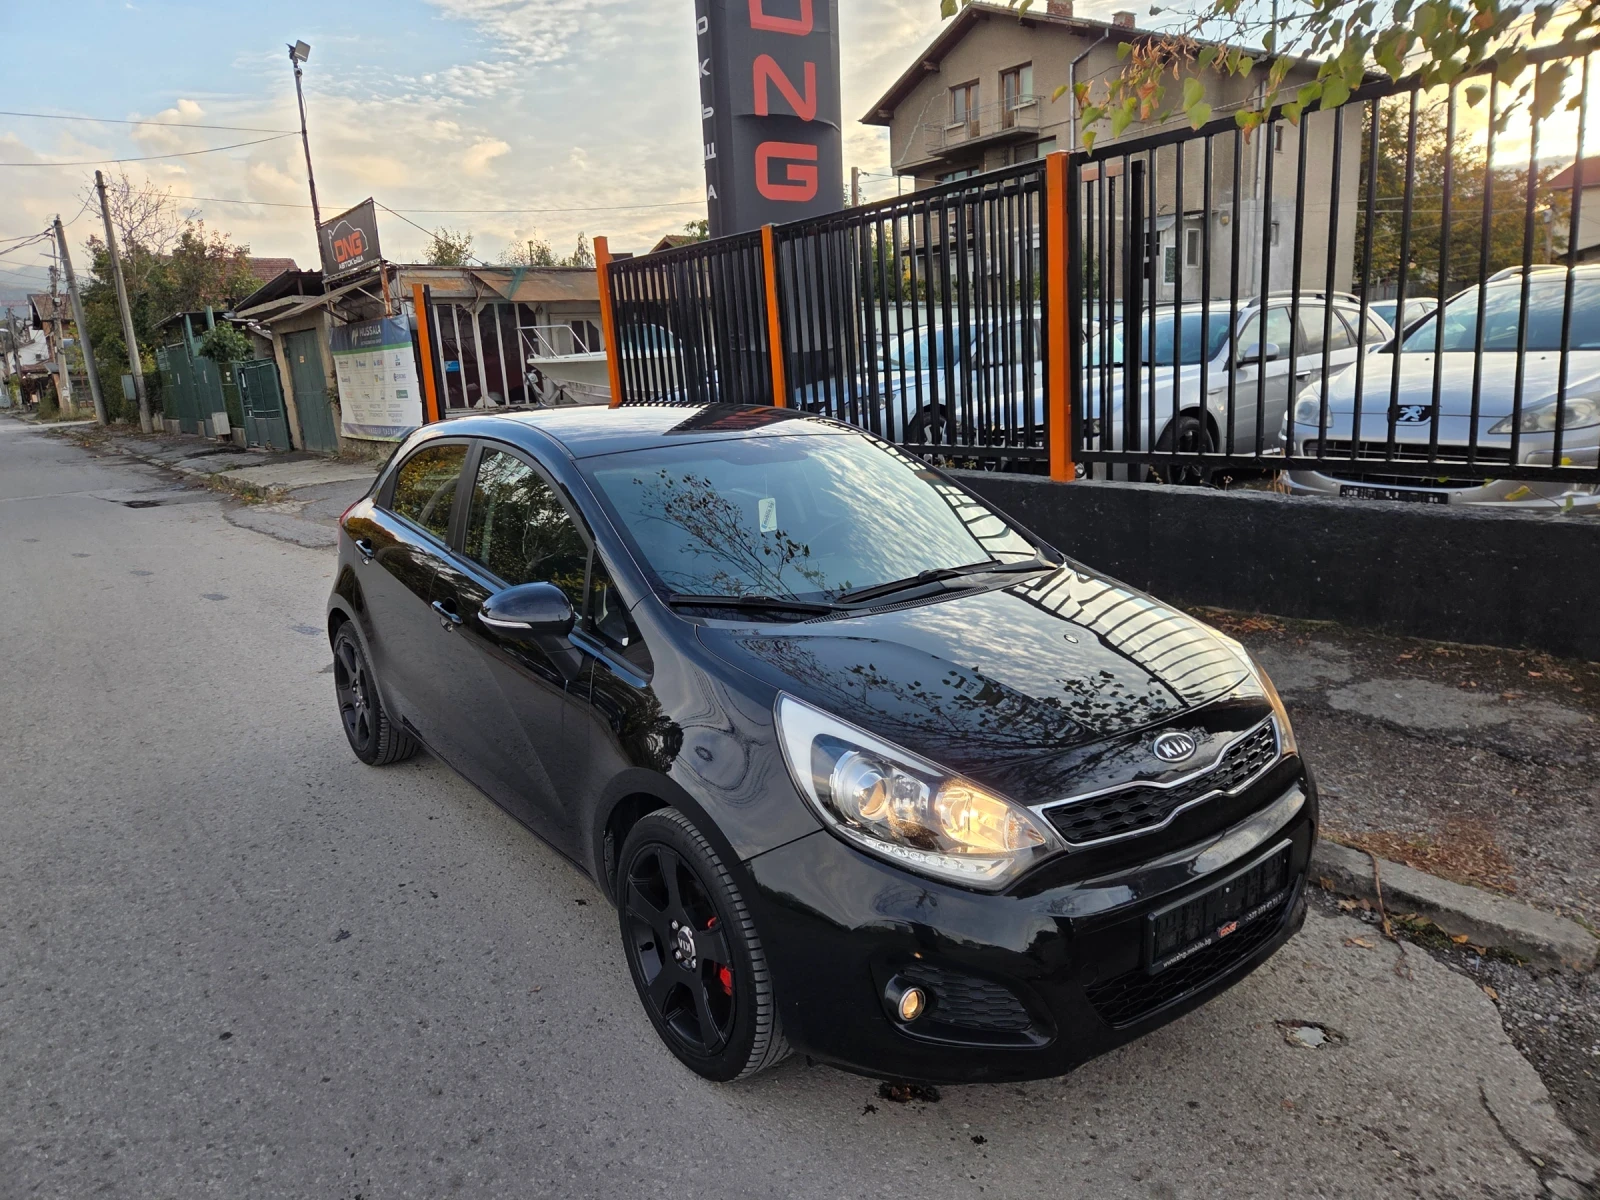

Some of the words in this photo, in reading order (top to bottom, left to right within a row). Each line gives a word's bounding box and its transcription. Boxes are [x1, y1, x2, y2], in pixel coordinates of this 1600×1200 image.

[333, 231, 362, 262] DNG
[338, 255, 364, 270] АВТОКЪЩА
[1159, 738, 1192, 758] KIA
[678, 937, 691, 952] KIA
